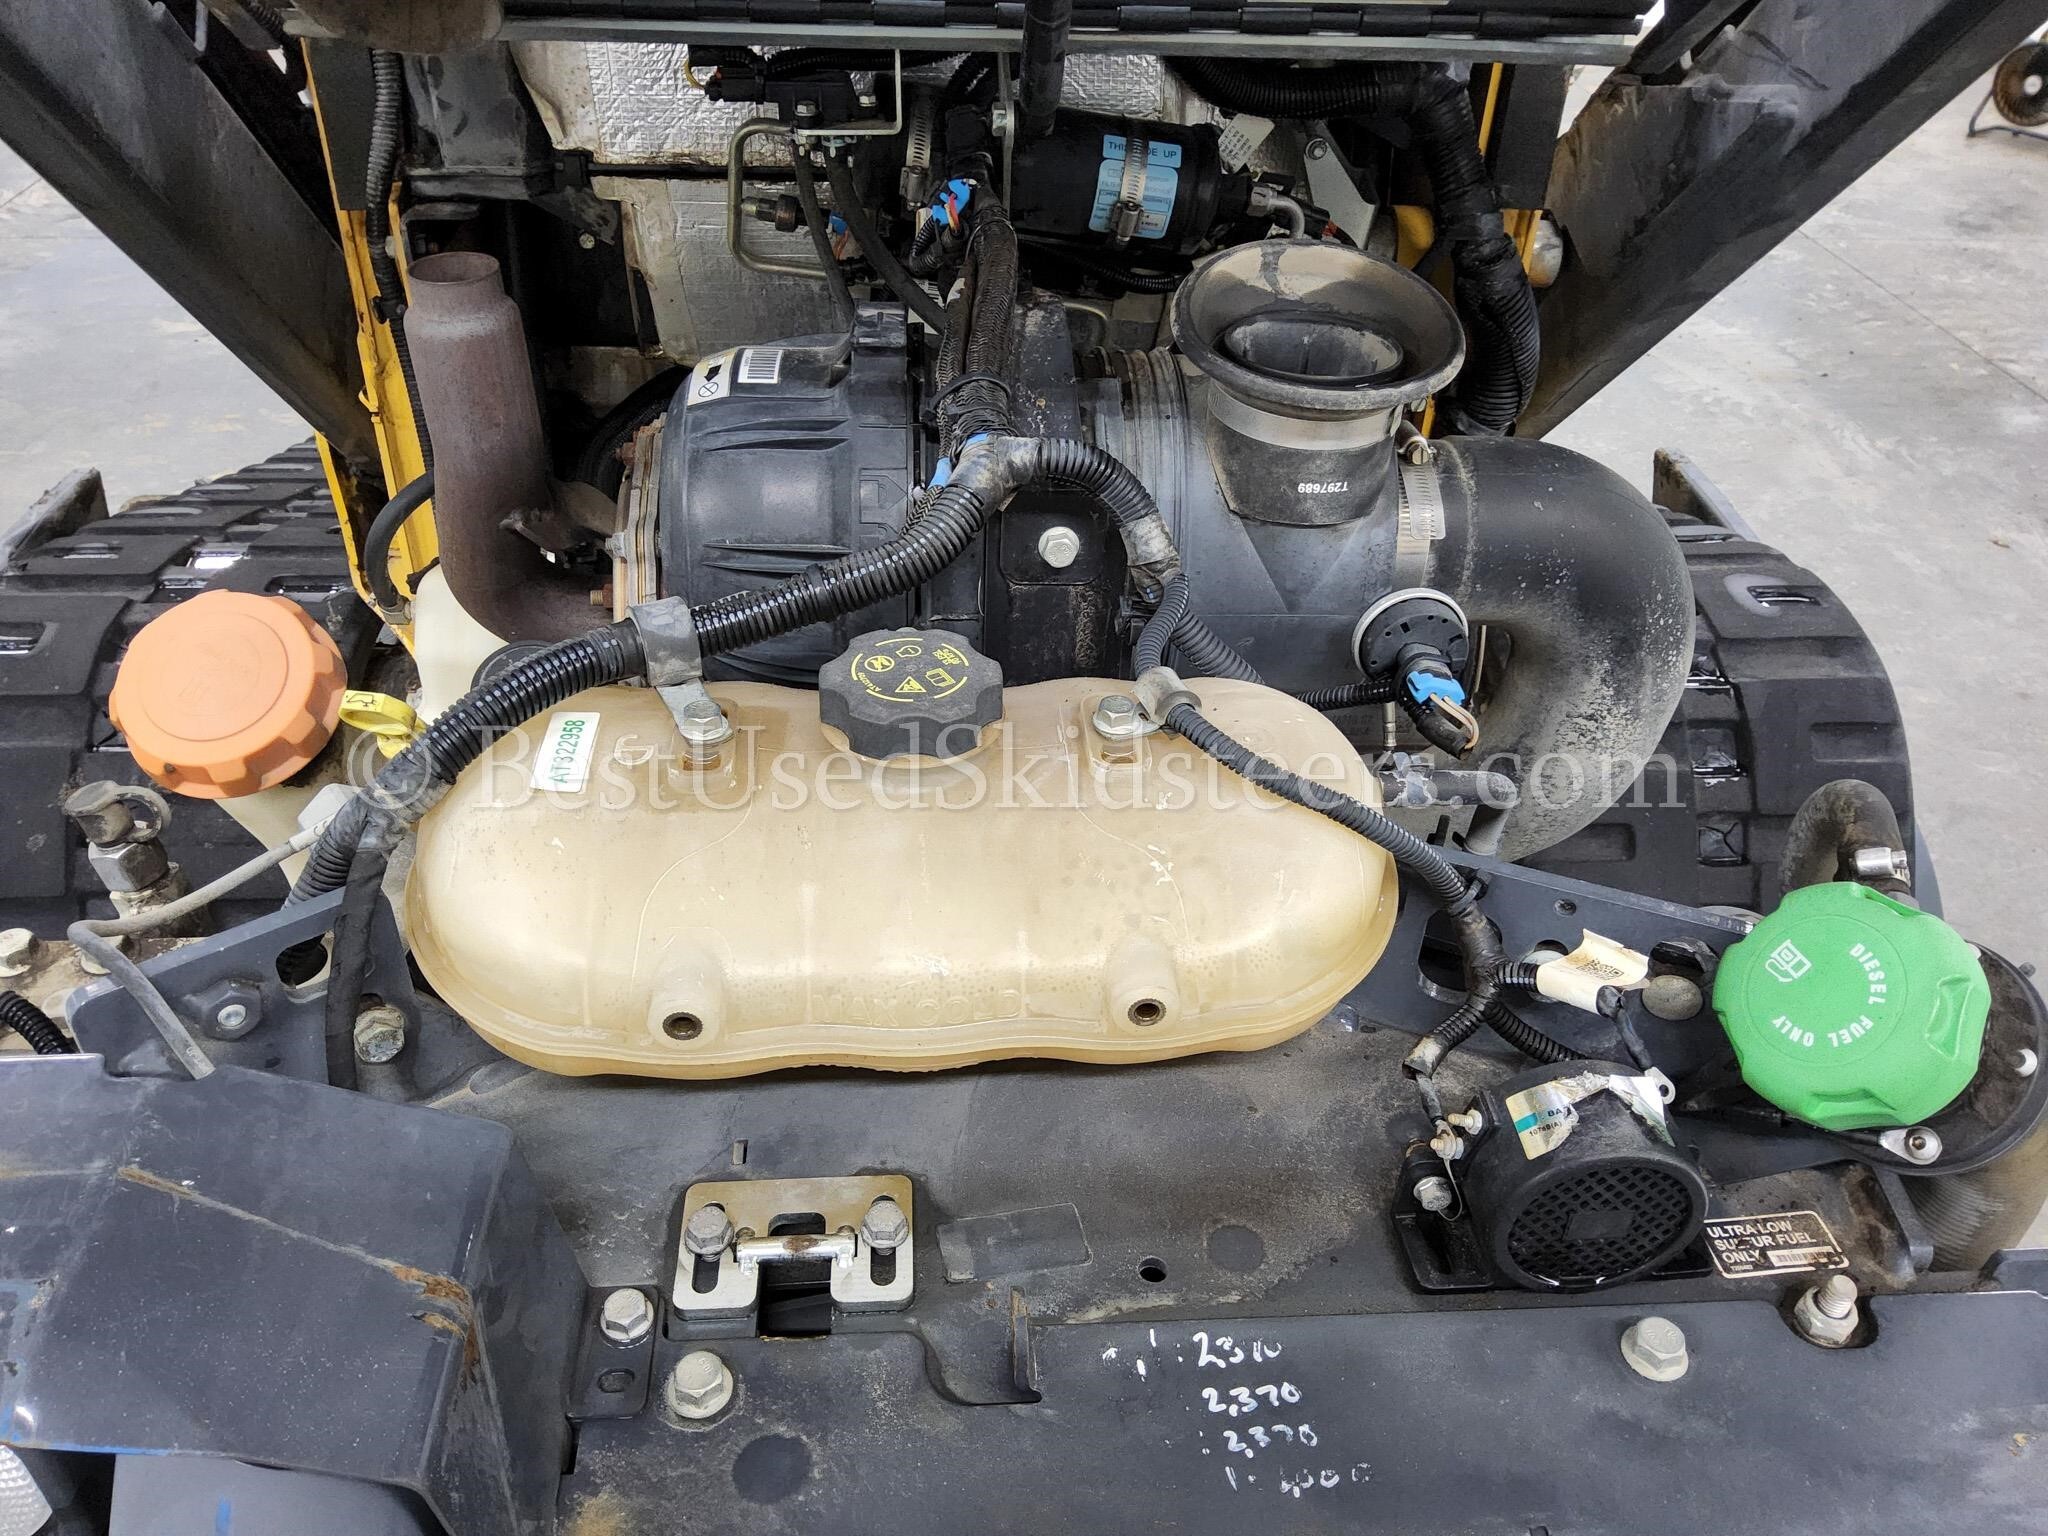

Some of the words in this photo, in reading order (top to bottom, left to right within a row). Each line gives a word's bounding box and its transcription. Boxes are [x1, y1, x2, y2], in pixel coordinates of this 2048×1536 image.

[1163, 150, 1177, 158] UP
[1297, 481, 1349, 494] T297689
[548, 720, 585, 784] AT322958
[1849, 943, 1887, 1004] DIESEL
[811, 994, 898, 1027] MAX
[917, 988, 1022, 1026] COLD
[1772, 1015, 1815, 1047] ONLY
[1827, 1015, 1874, 1047] FUEL
[1706, 1224, 1757, 1238] ULTRA
[1759, 1220, 1793, 1234] LOW
[1776, 1232, 1817, 1245] FUEL
[1722, 1249, 1764, 1265] ONLY
